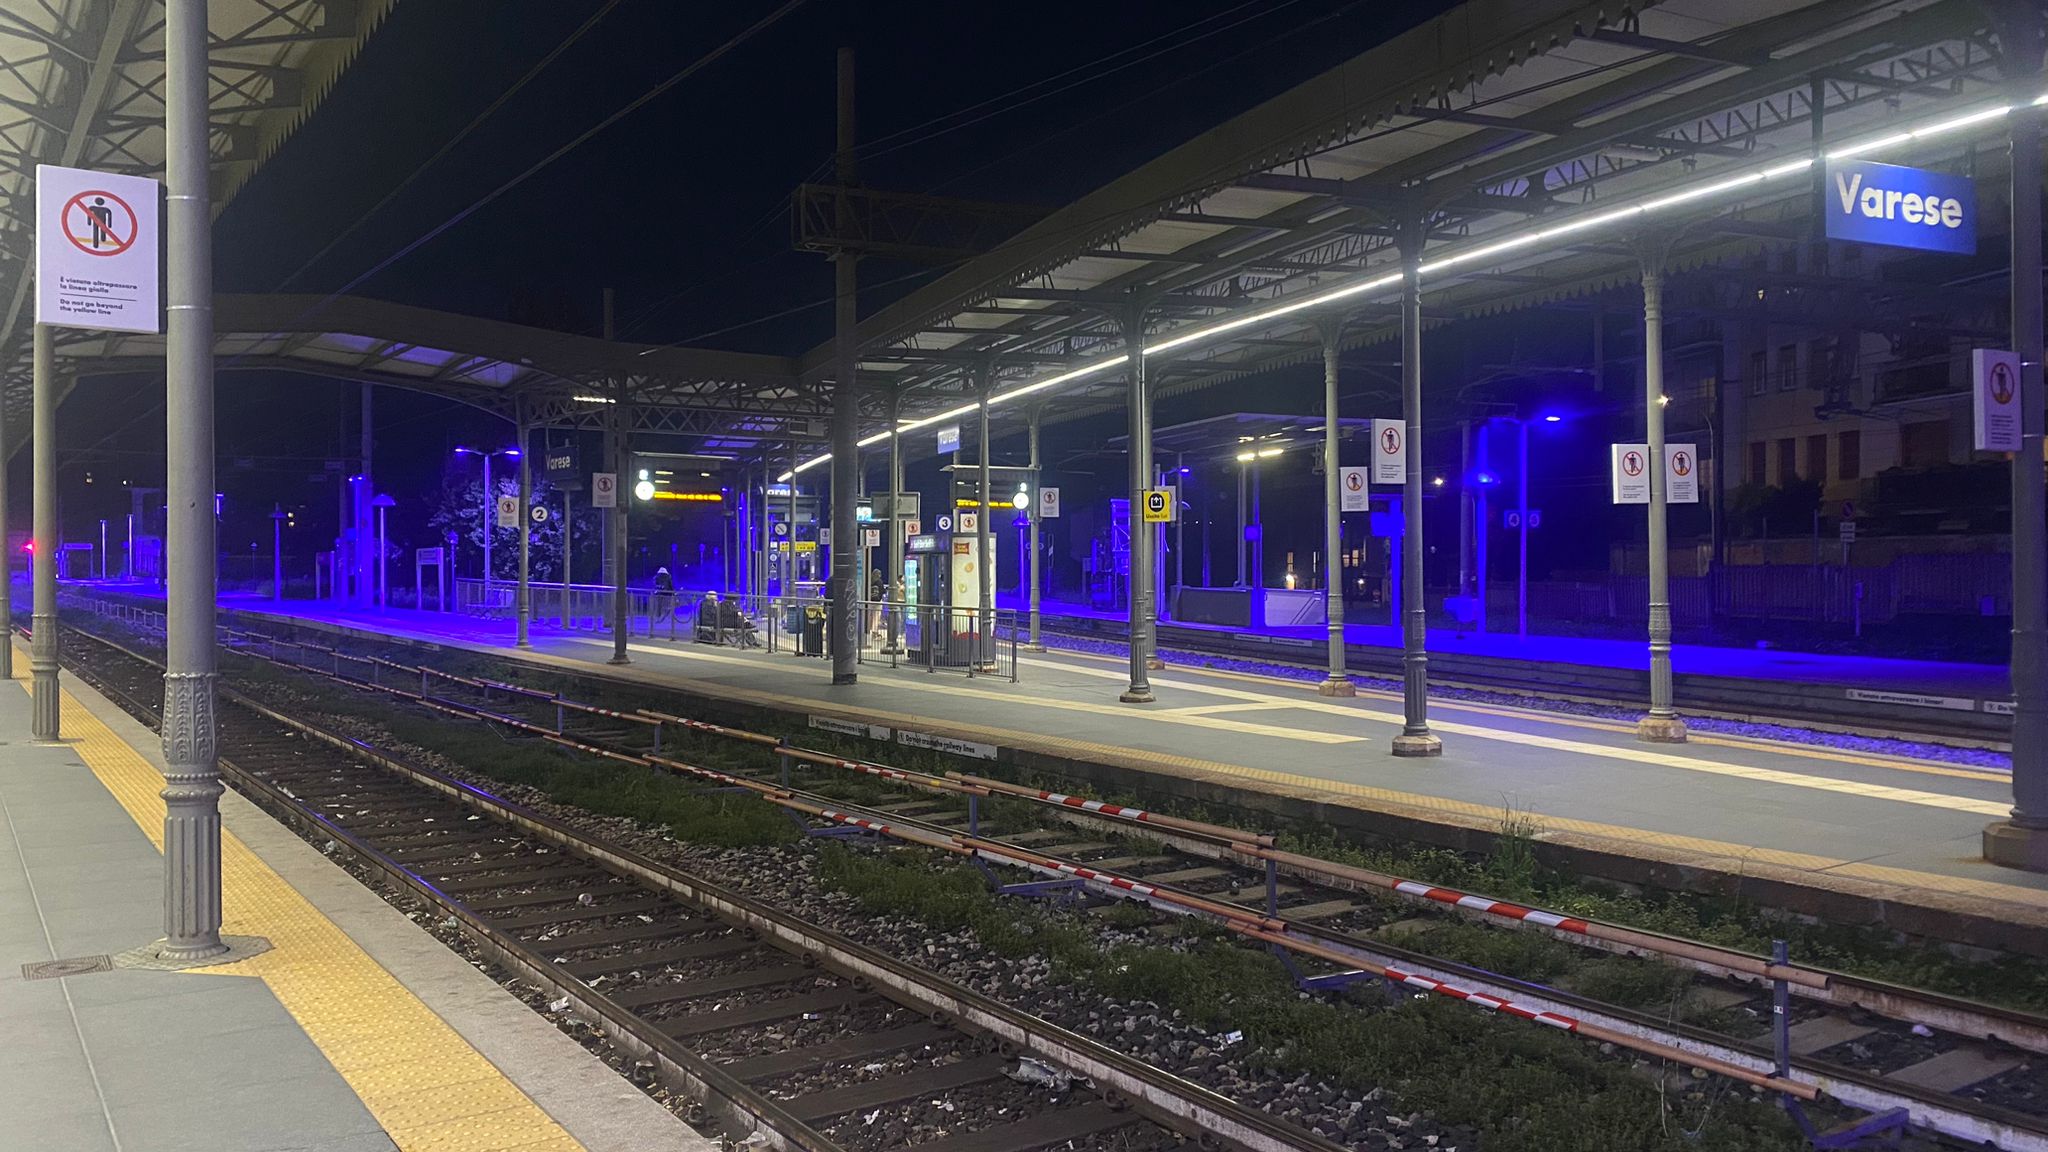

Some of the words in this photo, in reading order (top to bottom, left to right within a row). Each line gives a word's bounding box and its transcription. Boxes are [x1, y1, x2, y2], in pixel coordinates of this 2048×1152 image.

[1836, 171, 1964, 229] Varese
[93, 280, 138, 289] oltrepassare
[96, 301, 123, 309] beyond
[546, 455, 570, 470] Varese
[535, 509, 544, 519] 2
[963, 744, 975, 753] lines
